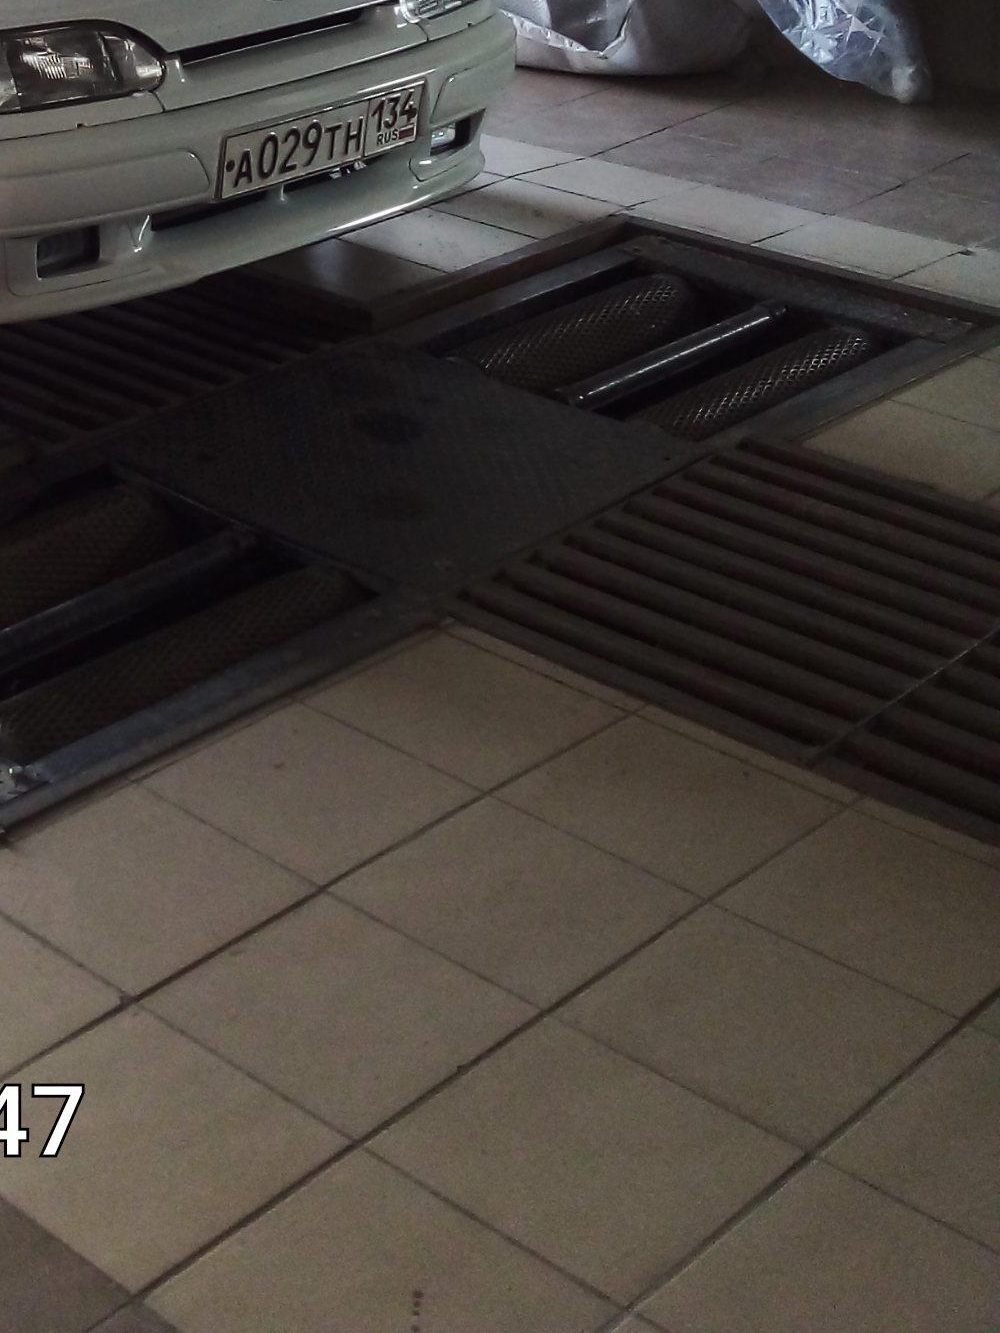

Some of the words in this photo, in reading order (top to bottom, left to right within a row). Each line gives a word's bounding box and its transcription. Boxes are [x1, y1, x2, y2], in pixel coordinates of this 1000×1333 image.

[233, 115, 364, 188] A029TH
[371, 88, 418, 133] 134
[376, 128, 399, 146] RUS
